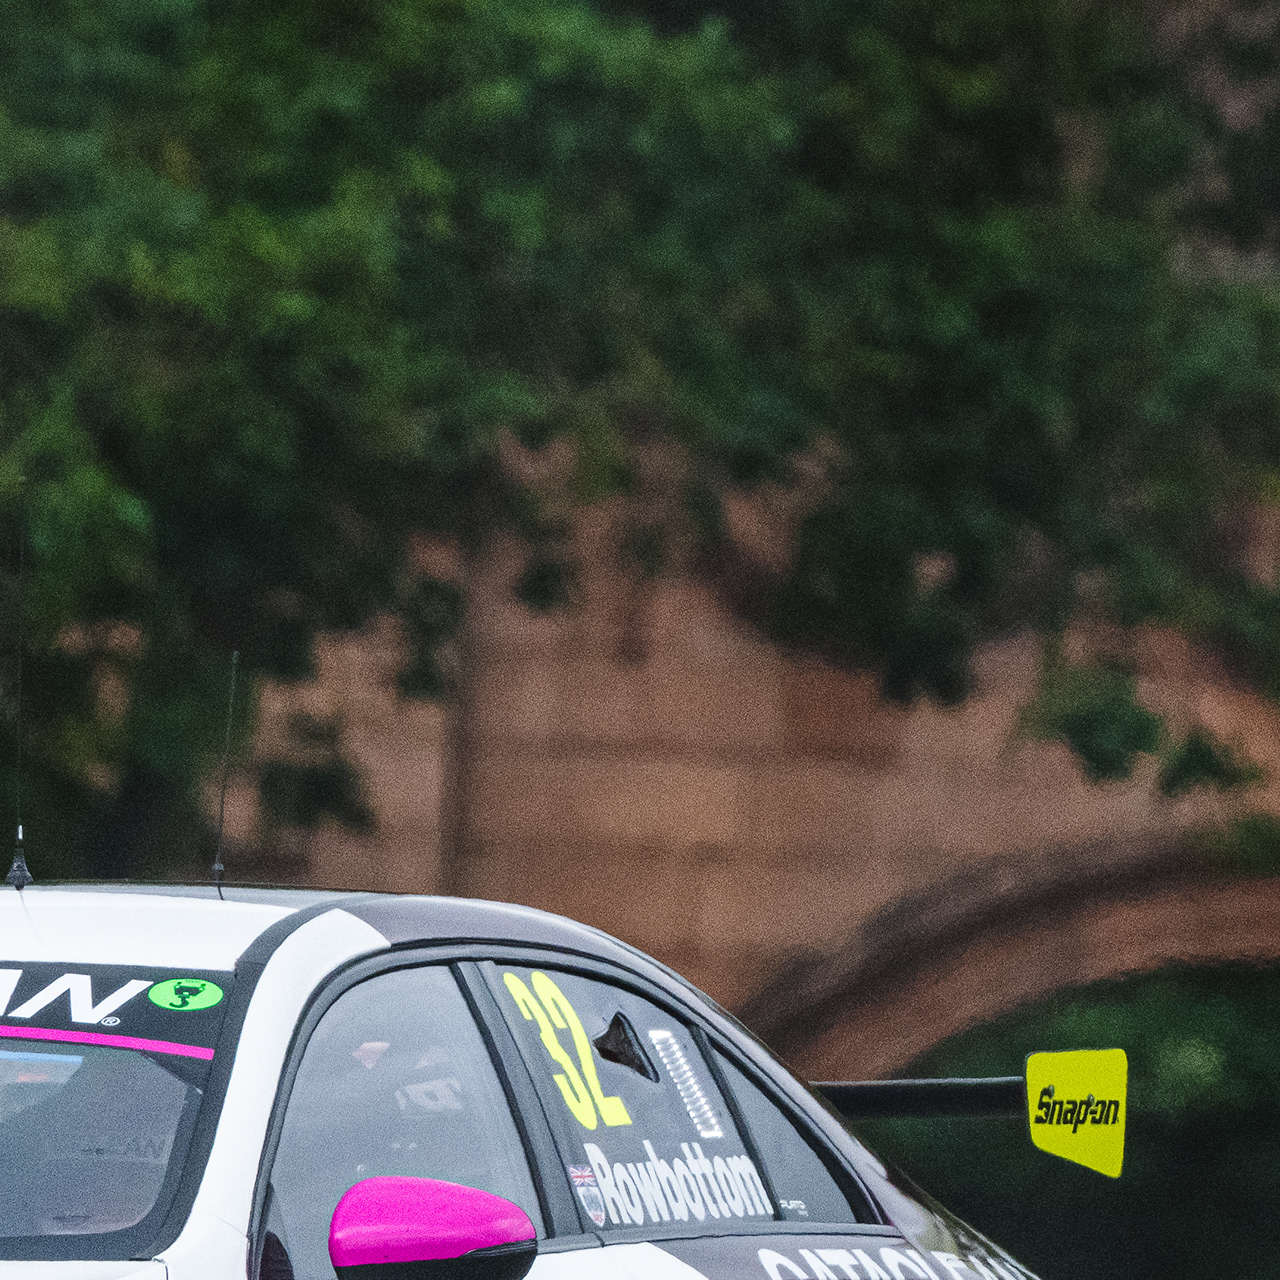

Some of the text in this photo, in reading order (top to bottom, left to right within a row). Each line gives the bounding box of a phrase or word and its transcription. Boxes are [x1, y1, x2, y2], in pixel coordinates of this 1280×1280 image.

[503, 970, 632, 1131] 32
[1034, 1085, 1120, 1134] Snap-on
[583, 1139, 775, 1226] Rowbottom
